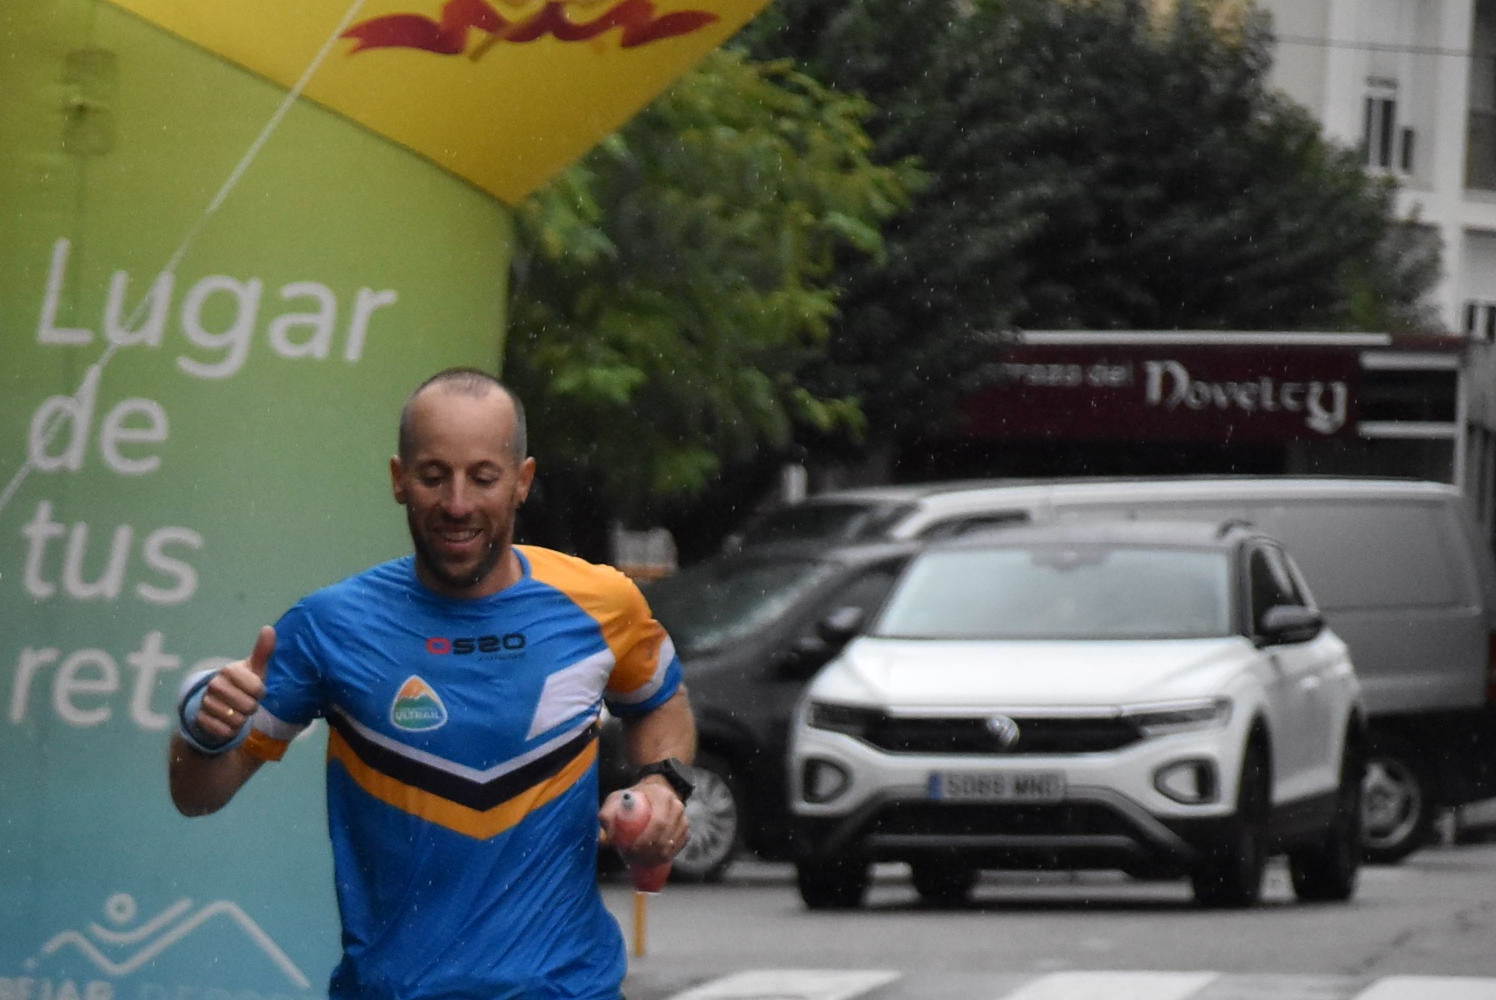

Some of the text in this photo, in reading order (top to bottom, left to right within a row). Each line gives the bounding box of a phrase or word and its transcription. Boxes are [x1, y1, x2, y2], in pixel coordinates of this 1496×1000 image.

[38, 238, 398, 379] Lugar
[29, 364, 169, 475] de
[24, 501, 203, 606] tus
[8, 631, 316, 742] ret
